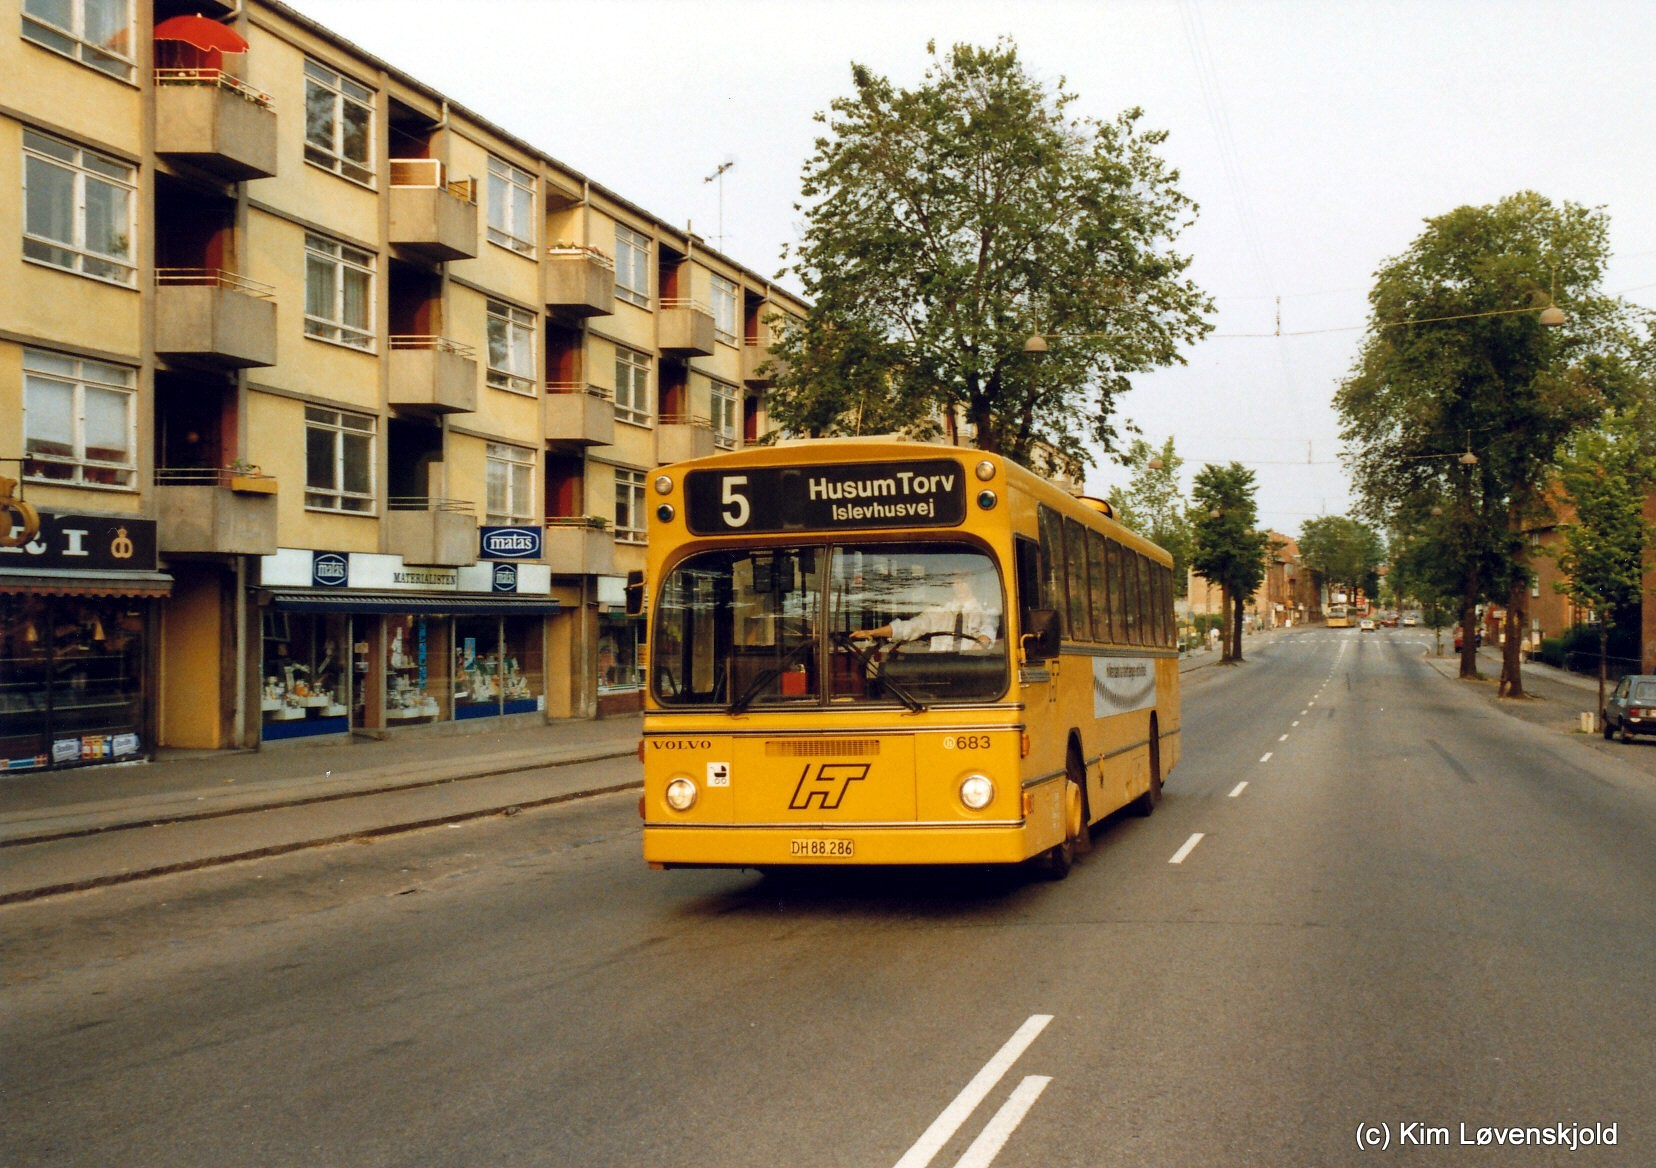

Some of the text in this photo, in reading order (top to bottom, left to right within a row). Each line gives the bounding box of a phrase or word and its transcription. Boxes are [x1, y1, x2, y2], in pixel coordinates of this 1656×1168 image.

[809, 472, 955, 500] Husum Torv
[721, 475, 750, 528] 5
[832, 499, 935, 521] Islevhusvej
[489, 534, 533, 550] matas
[318, 560, 344, 577] matas
[393, 572, 456, 586] MATERIALISTEN
[496, 570, 516, 585] matas
[653, 740, 712, 750] VOLVO
[956, 735, 992, 750] 683
